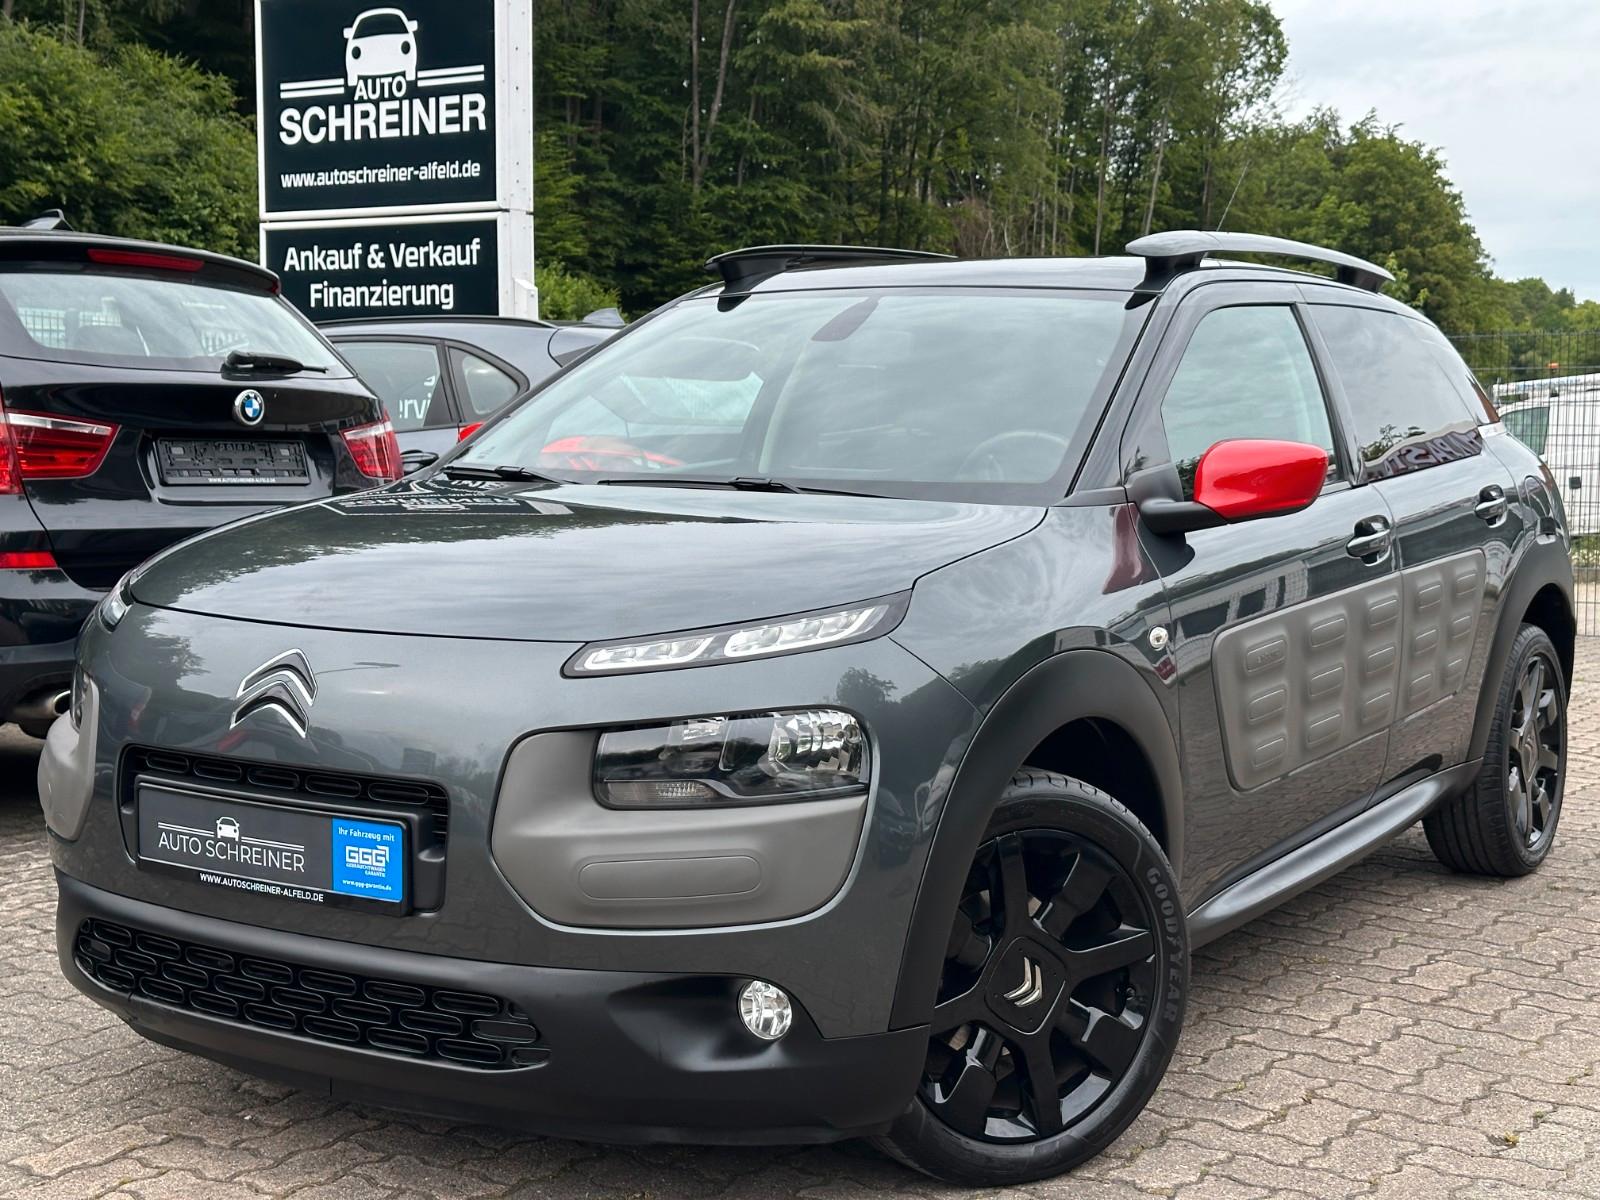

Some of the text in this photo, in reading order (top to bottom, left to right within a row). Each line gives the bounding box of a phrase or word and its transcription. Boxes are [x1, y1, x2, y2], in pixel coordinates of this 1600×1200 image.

[354, 75, 407, 101] AUTO
[279, 93, 486, 145] SCHREINER
[281, 160, 480, 188] www.autoschreiner-alfeld.de
[284, 238, 480, 271] Ankauf & Verkauf
[310, 279, 454, 310] Finanzierung
[338, 827, 395, 842] Ihr Fahrzeug mit
[158, 832, 305, 872] AUTO SCHREINER
[346, 845, 386, 867] GGG
[200, 872, 324, 902] WWW.AUTOSCHREINER-ALFELD.DE
[1146, 867, 1184, 1022] GOODYEAR
